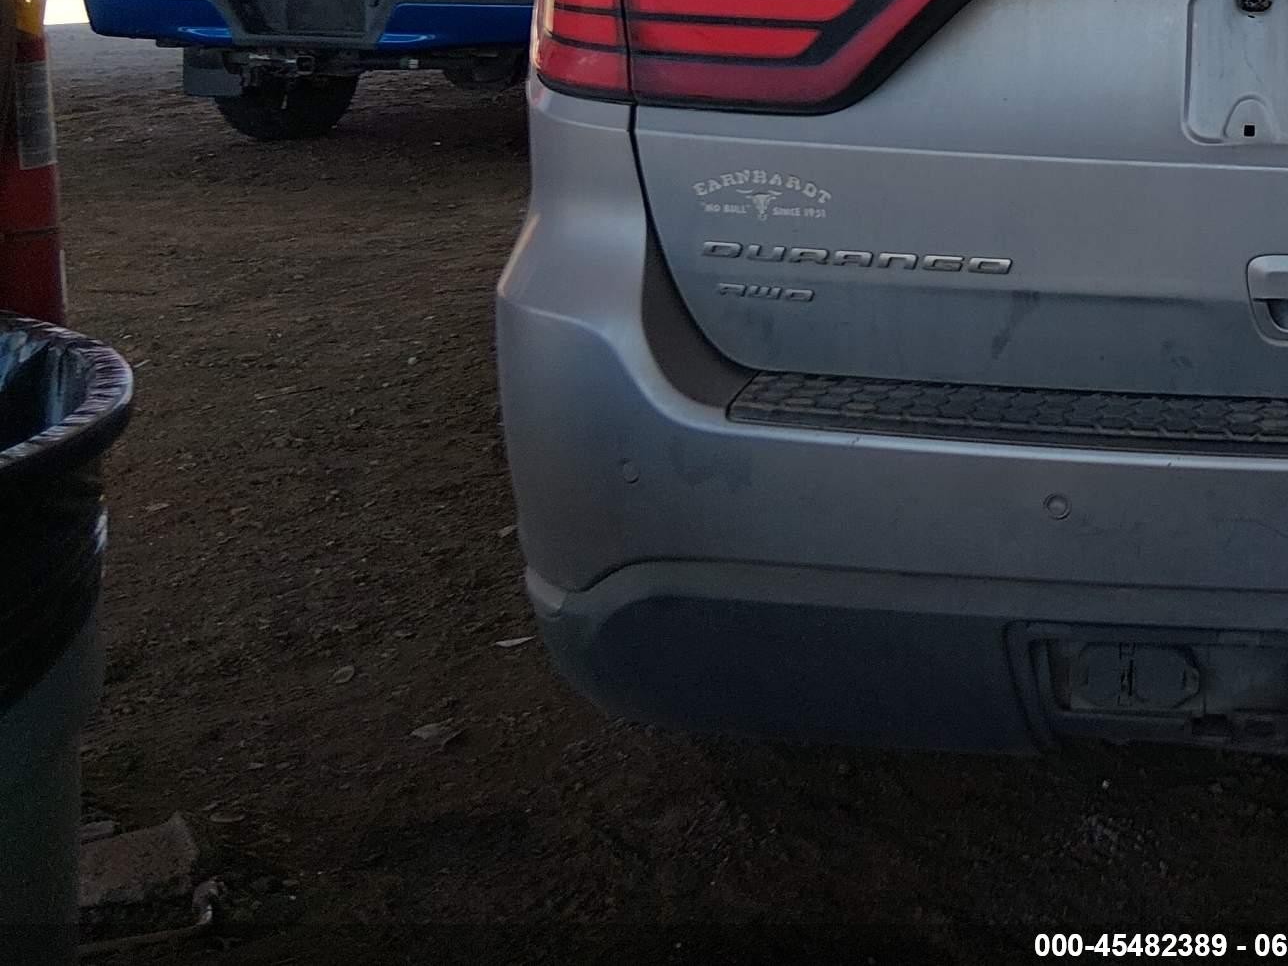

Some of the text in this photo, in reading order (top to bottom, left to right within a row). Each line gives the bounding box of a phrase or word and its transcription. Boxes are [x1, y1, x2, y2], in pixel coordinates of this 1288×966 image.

[693, 169, 832, 204] EARNHARDT
[772, 206, 801, 217] SINCE
[701, 240, 1014, 275] DURANGO
[717, 282, 816, 303] AWD
